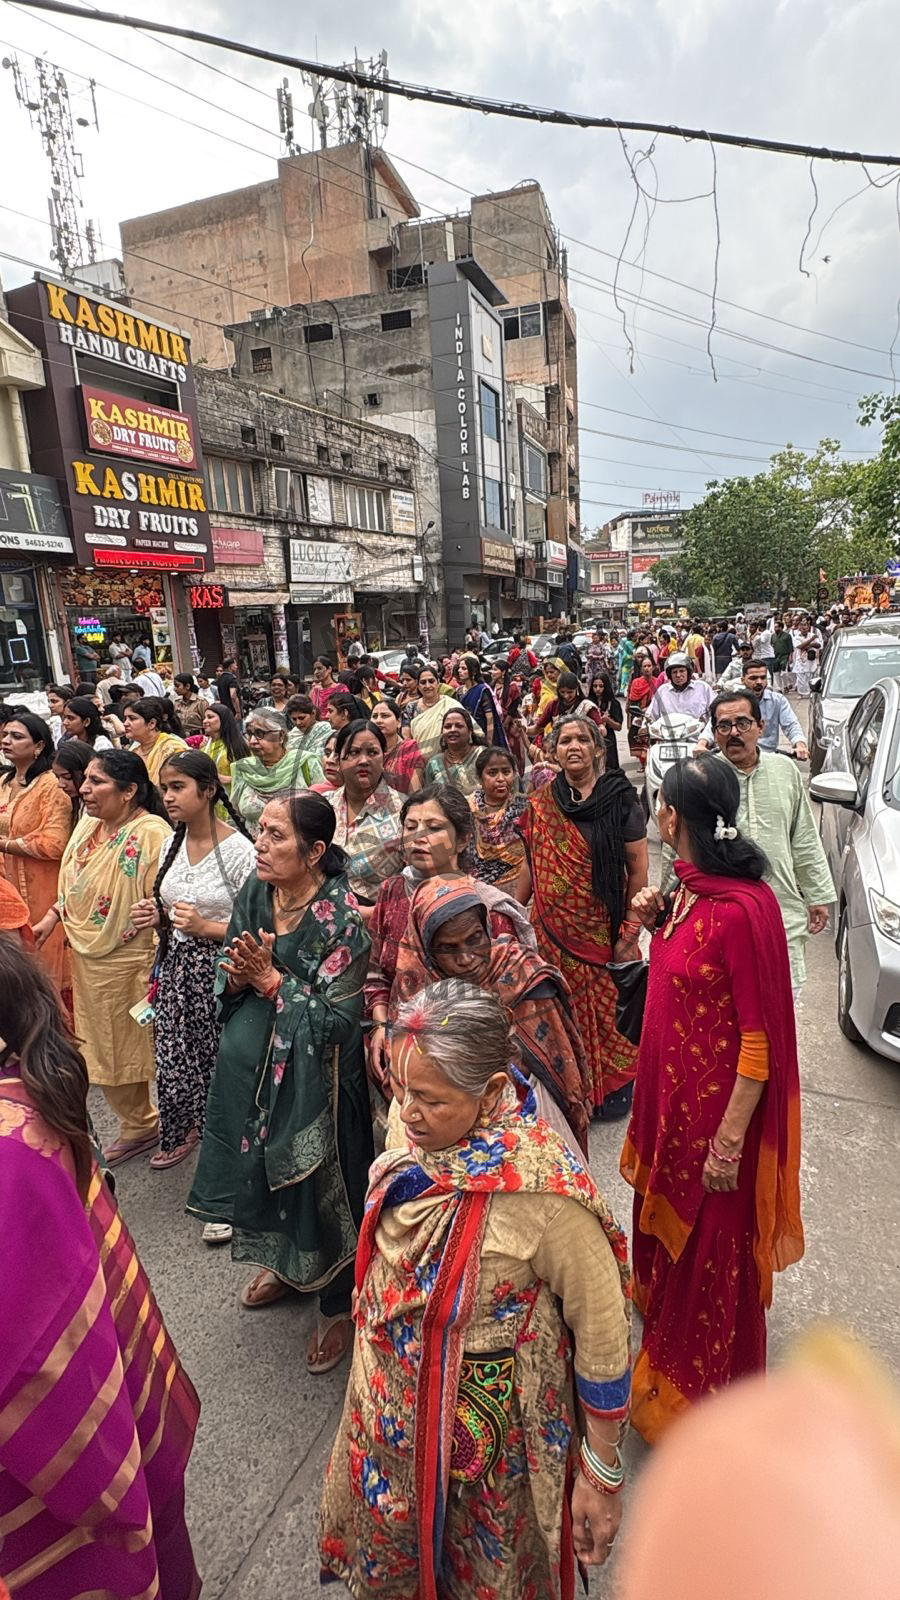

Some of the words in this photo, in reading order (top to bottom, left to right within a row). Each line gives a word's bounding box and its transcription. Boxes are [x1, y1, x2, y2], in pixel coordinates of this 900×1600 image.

[47, 283, 189, 366] KASHMIR
[59, 322, 121, 361] HANDI
[125, 346, 187, 383] CRAFTS
[455, 313, 466, 382] INDIA
[88, 398, 190, 441] KASHMIR
[112, 426, 136, 444] DRY
[138, 432, 176, 453] FRUITS
[457, 387, 469, 455] COLOR
[72, 461, 206, 512] KASHMIR
[462, 461, 471, 500] LAB
[93, 505, 131, 529] DRY
[138, 511, 199, 536] FRUITS
[292, 543, 329, 562] LUCKY
[191, 587, 223, 607] KAS
